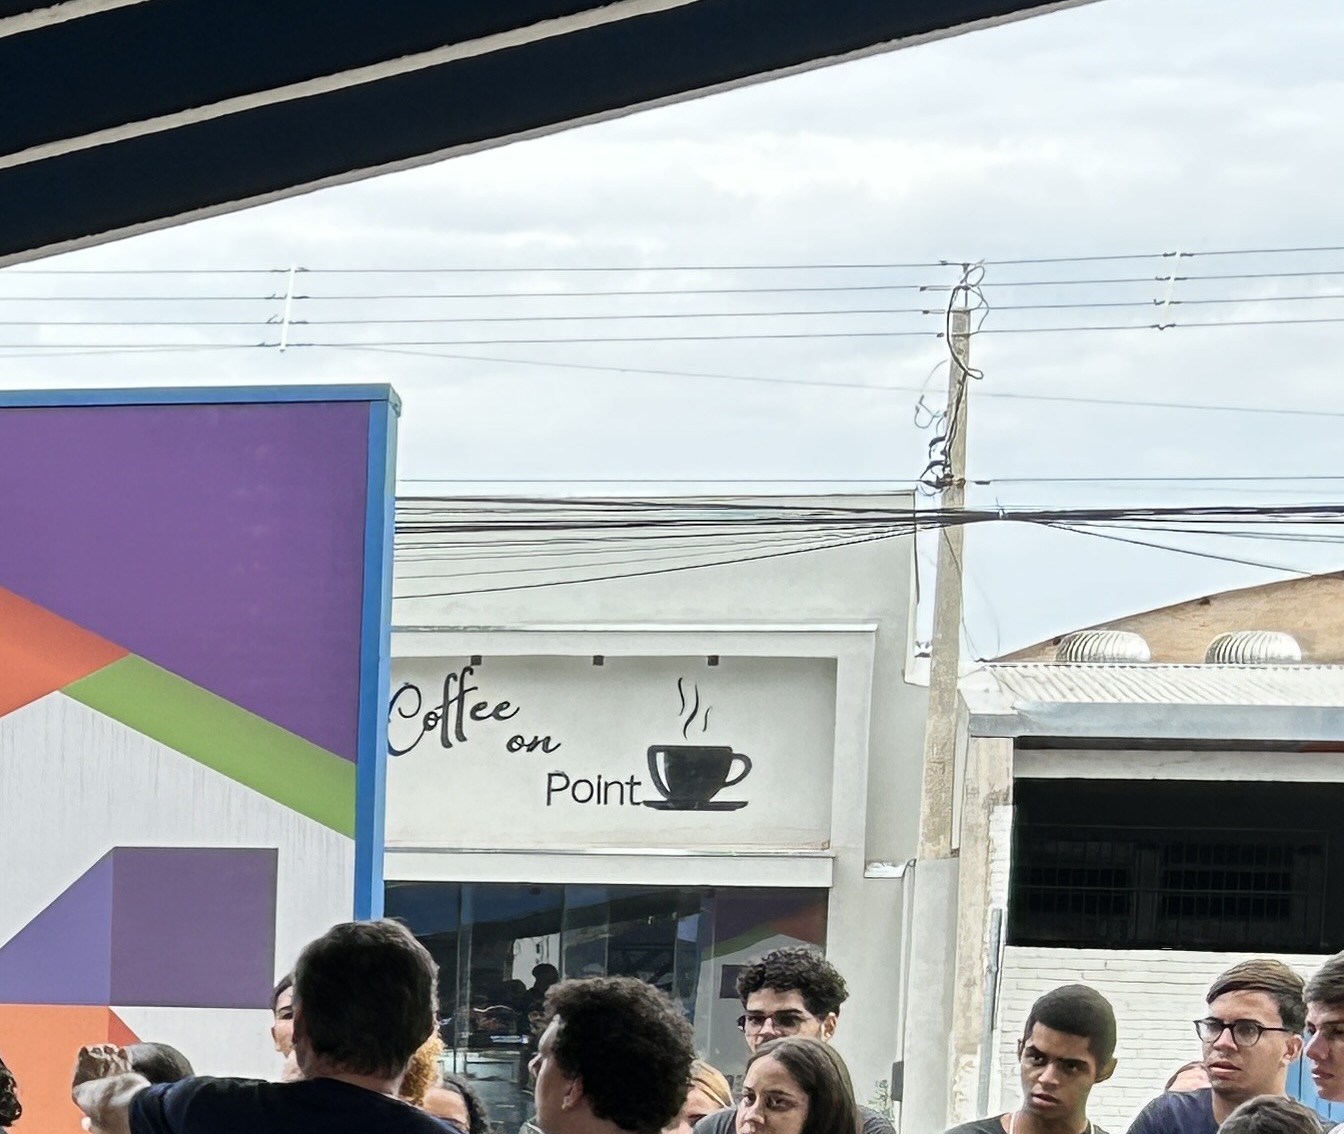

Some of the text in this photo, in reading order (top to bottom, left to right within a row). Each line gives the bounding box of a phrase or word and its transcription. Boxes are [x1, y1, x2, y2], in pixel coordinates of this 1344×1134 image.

[387, 665, 520, 757] Coffee
[505, 733, 561, 754] on
[546, 771, 642, 806] Point
